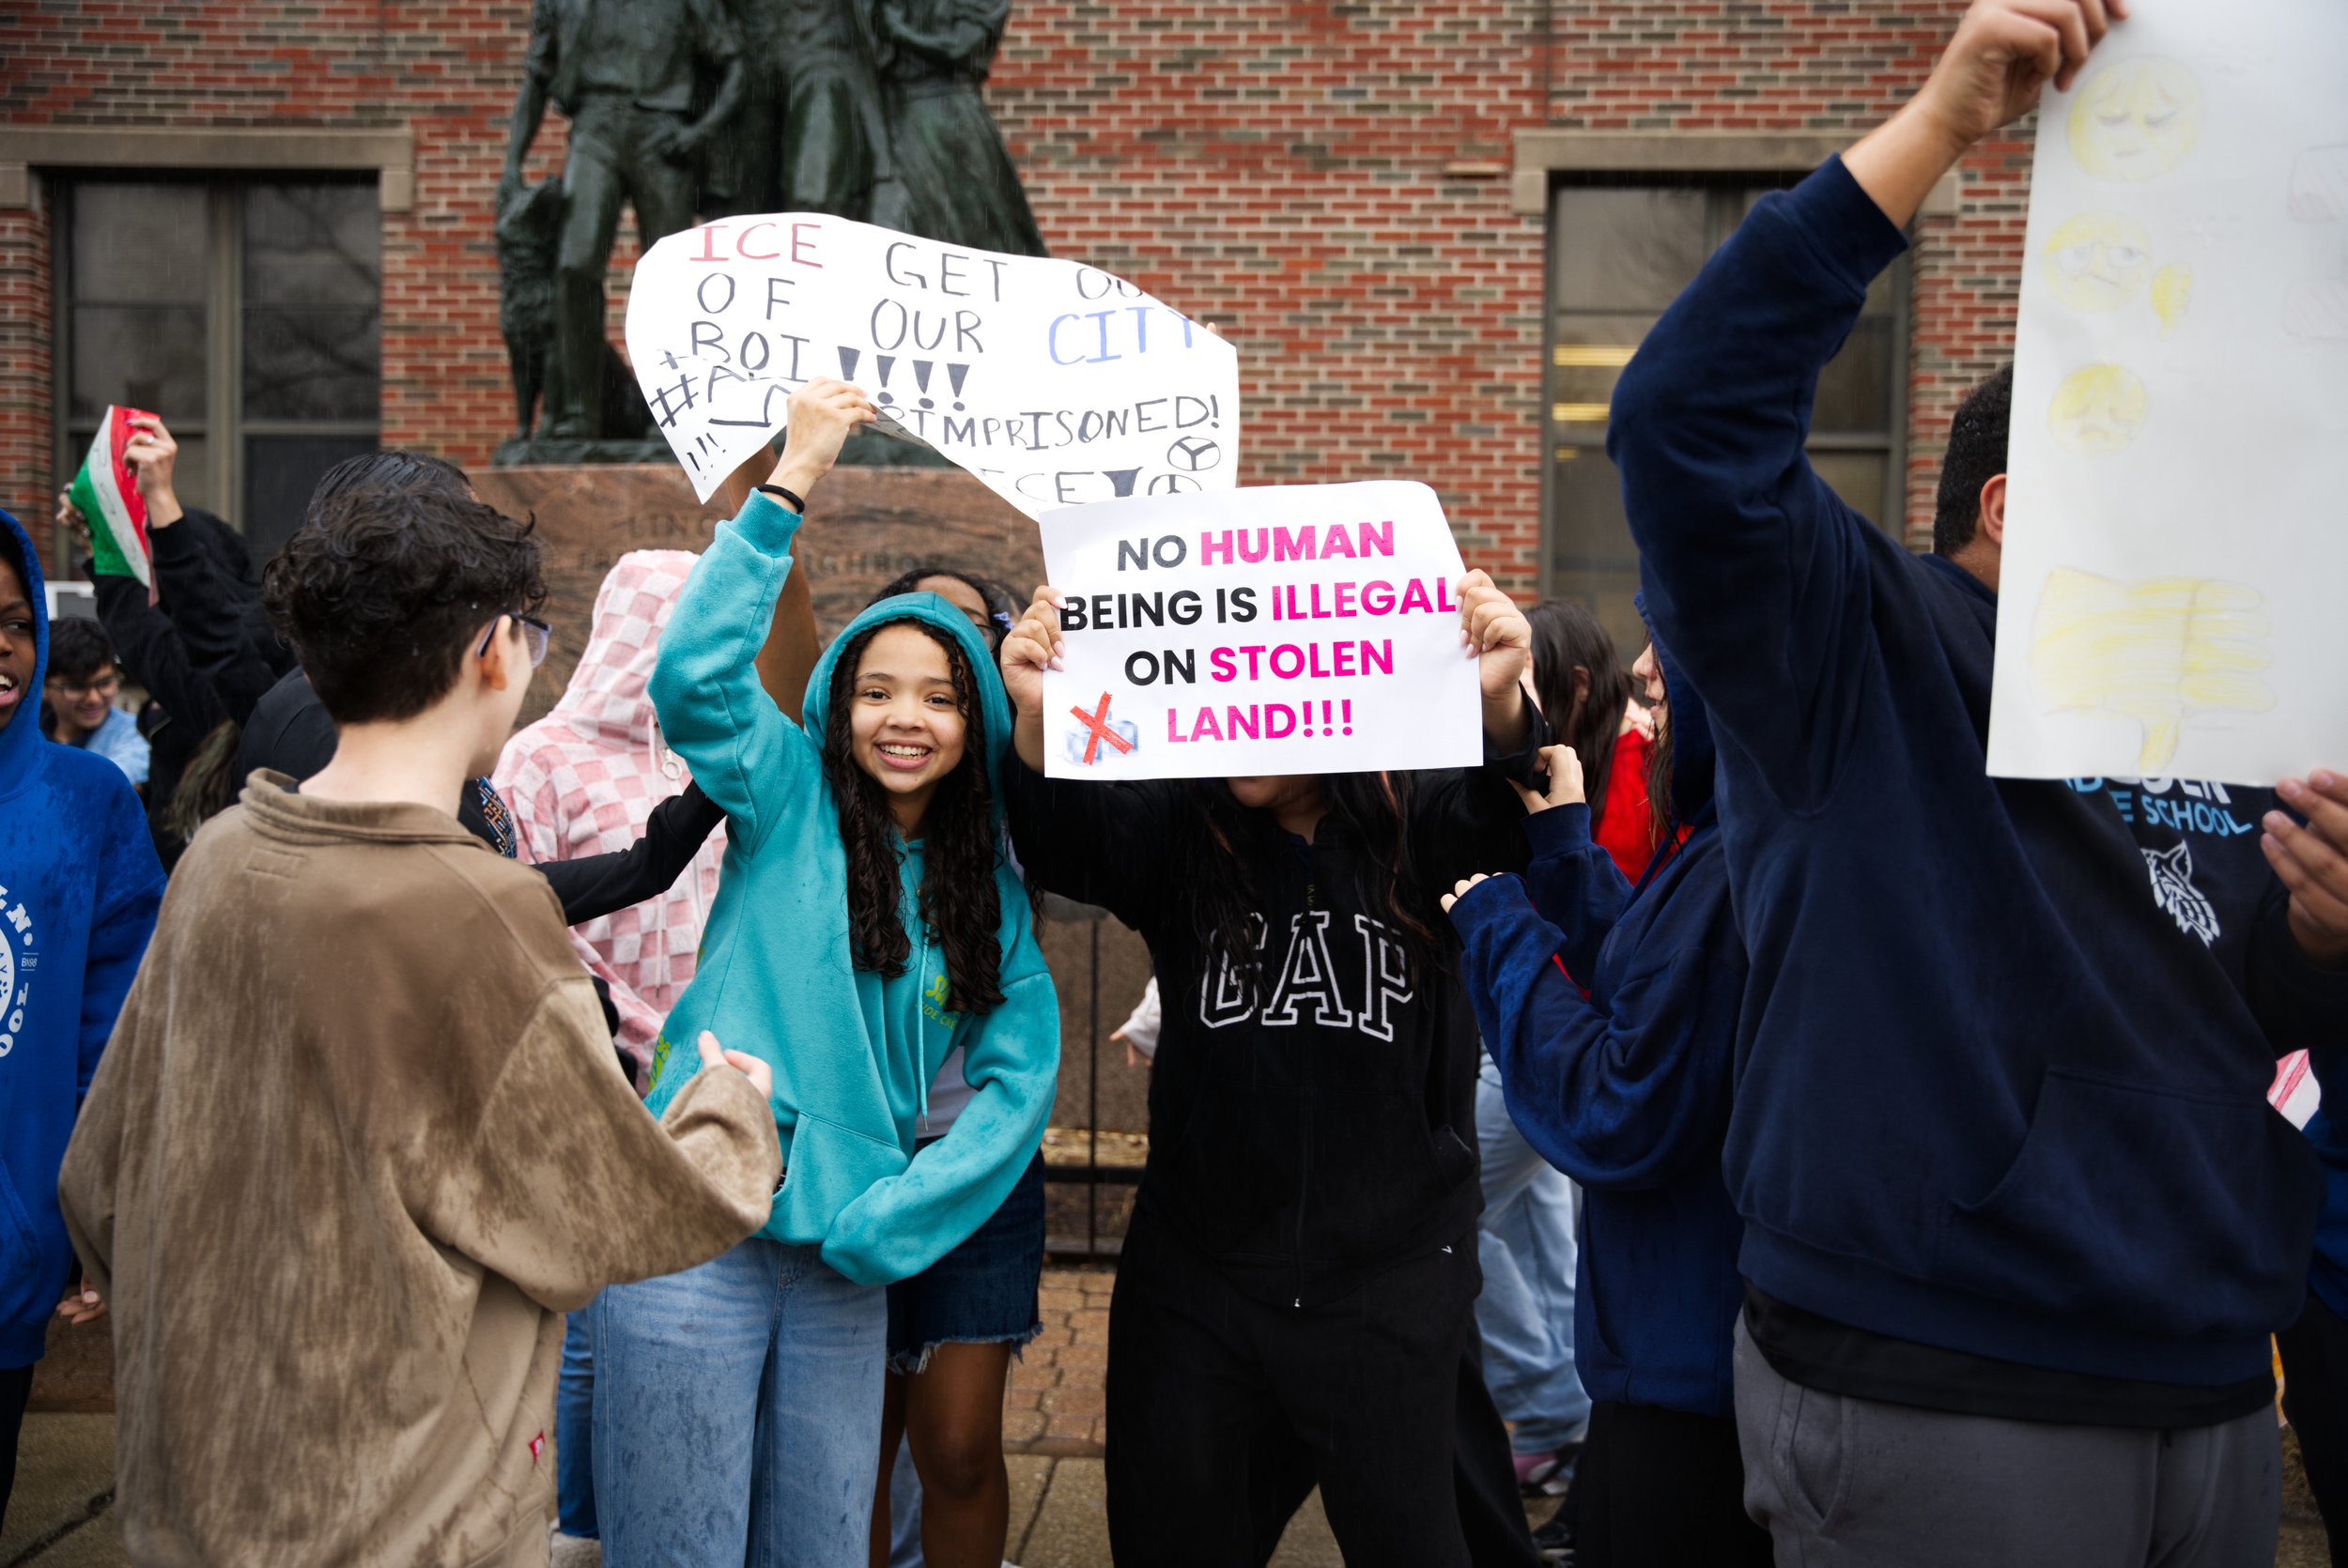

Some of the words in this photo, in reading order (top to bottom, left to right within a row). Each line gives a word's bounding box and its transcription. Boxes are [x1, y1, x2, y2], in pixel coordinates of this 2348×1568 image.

[689, 223, 823, 269] ICE
[886, 242, 1008, 302] GET
[1076, 267, 1145, 300] OU
[698, 272, 796, 320] OF
[872, 298, 983, 353] OUR
[1048, 306, 1193, 365] CITY
[1117, 534, 1187, 572] NO
[1199, 520, 1395, 566] HUMAN
[1059, 590, 1202, 632] BEING
[1216, 587, 1258, 624] IS
[1272, 576, 1457, 622] ILLEGAL
[1124, 648, 1196, 686] ON
[1210, 638, 1394, 683] STOLEN
[1166, 699, 1353, 743] LAND!!!
[2140, 795, 2253, 837] SCHOOL
[1200, 911, 1413, 1042] GAP
